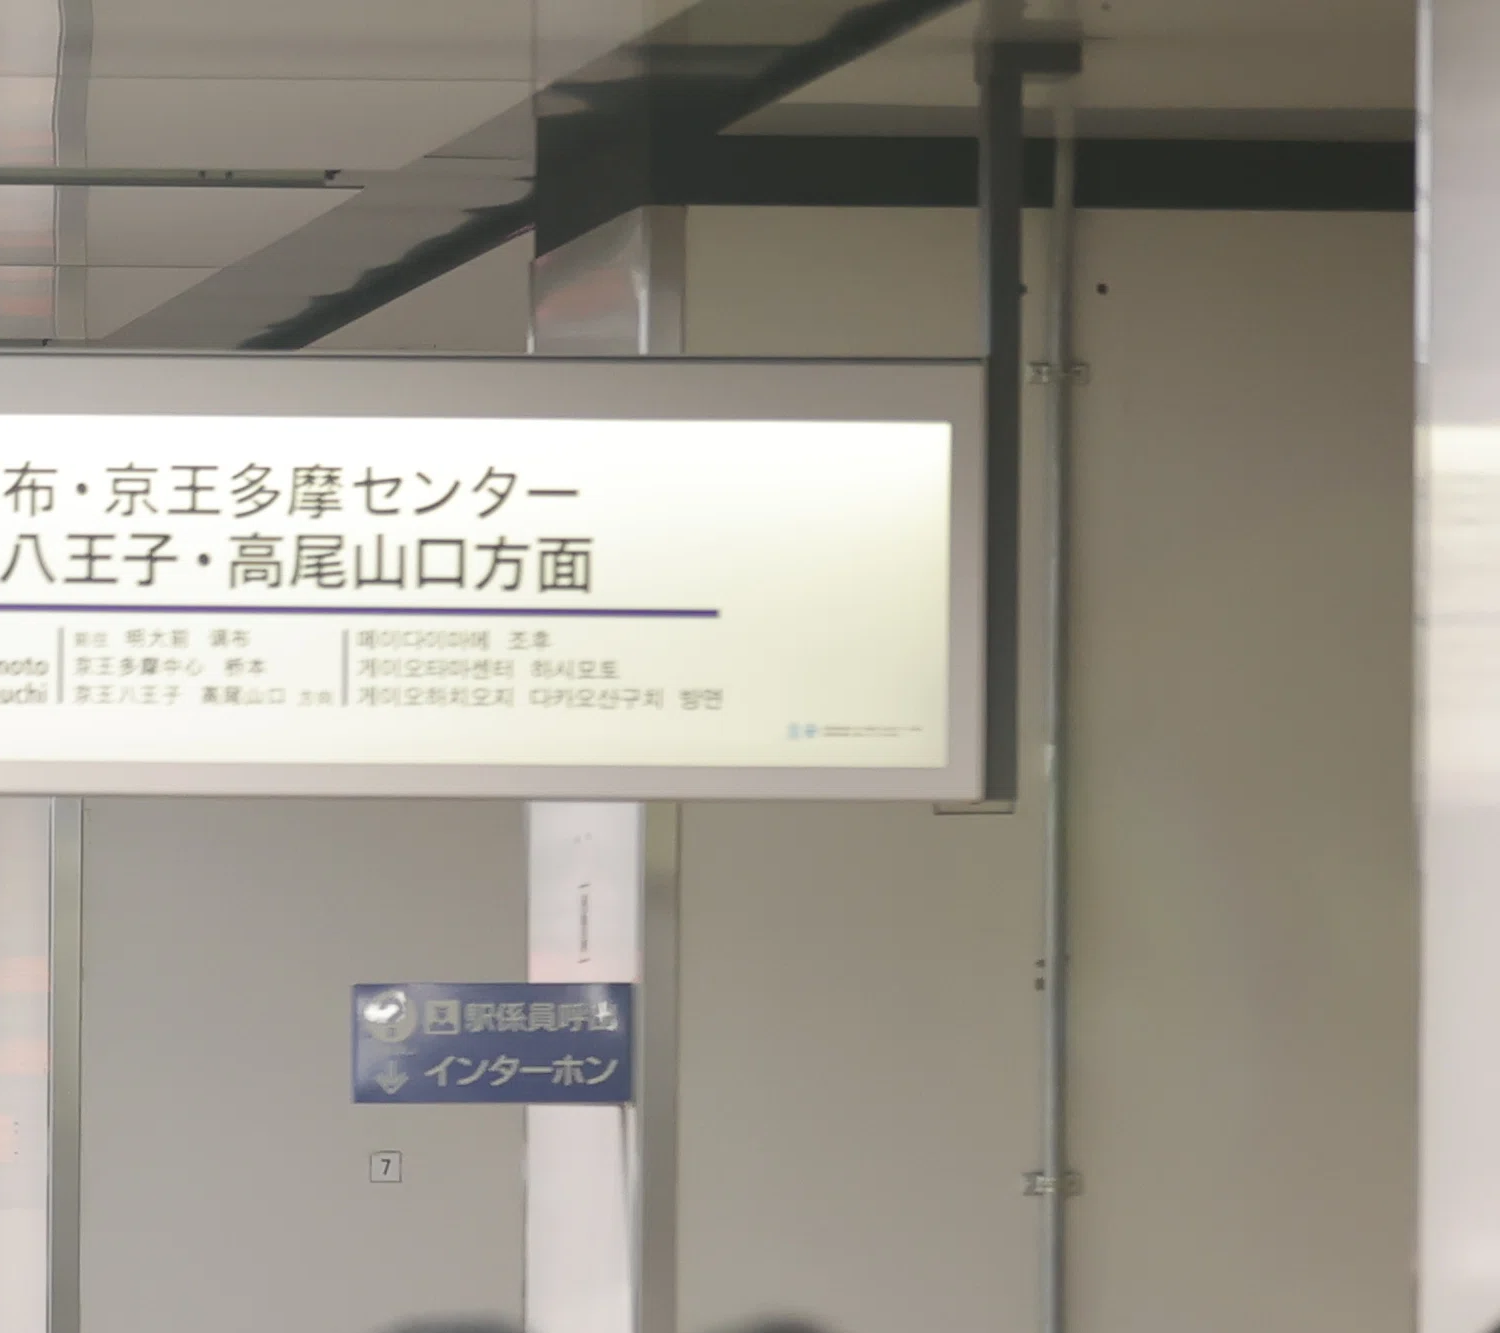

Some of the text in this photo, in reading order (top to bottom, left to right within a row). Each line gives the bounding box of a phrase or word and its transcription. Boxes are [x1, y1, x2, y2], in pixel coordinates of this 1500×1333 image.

[423, 1054, 620, 1087] インターホン
[380, 1158, 392, 1176] 7
